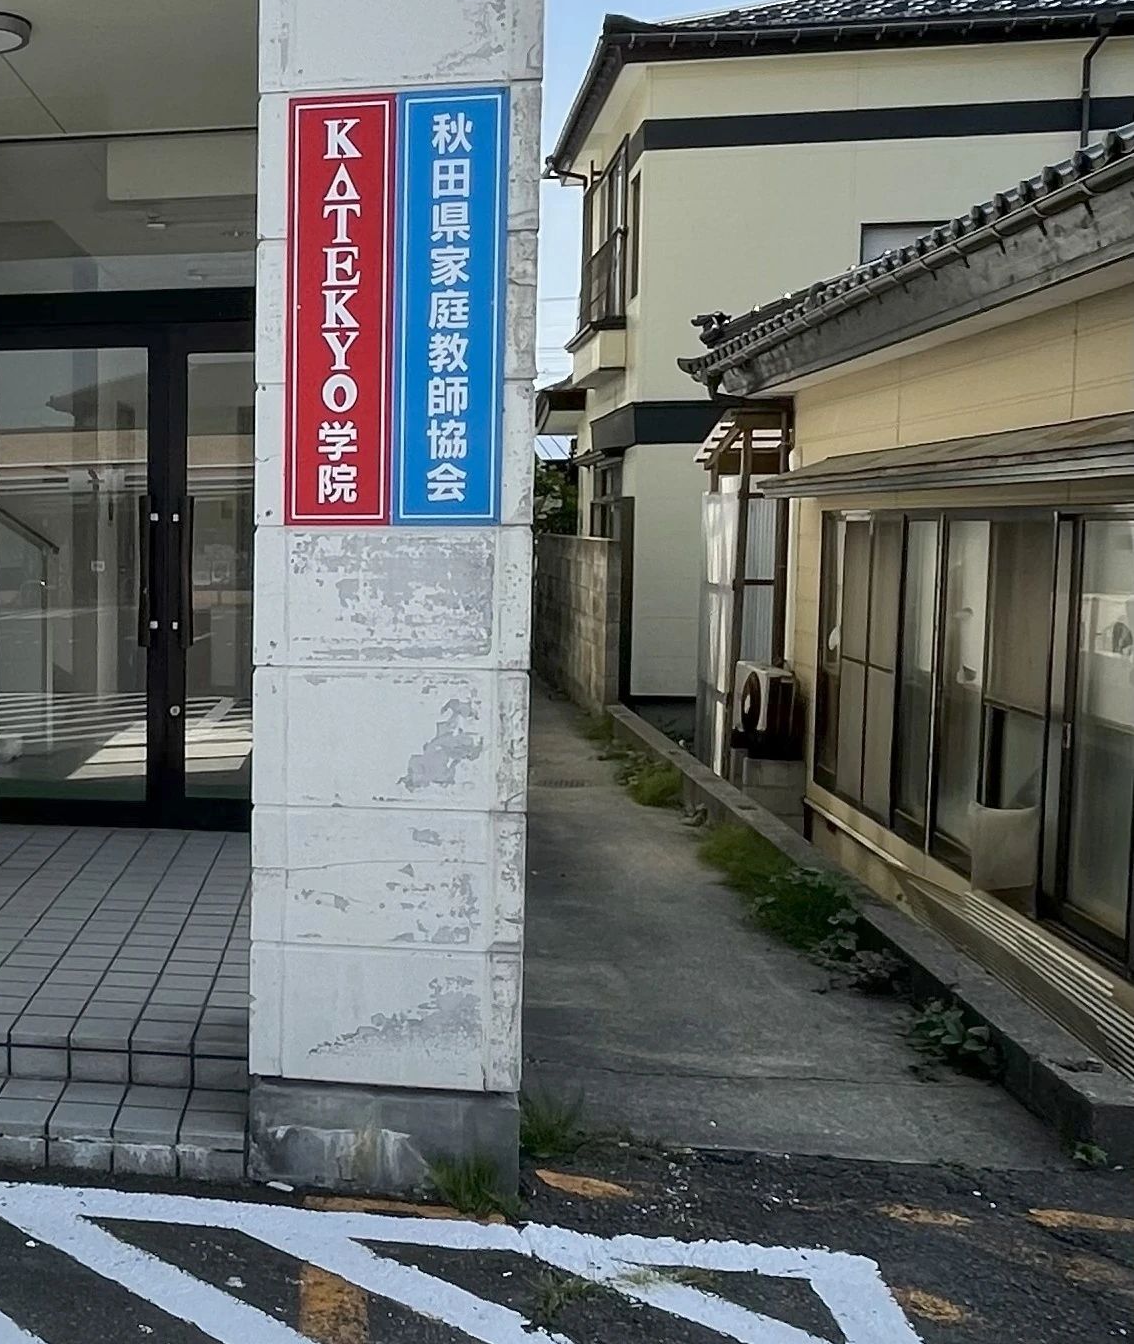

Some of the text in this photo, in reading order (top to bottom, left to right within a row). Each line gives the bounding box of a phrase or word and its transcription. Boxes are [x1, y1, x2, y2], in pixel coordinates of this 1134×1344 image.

[426, 111, 473, 503] 秋田県家庭教師協会
